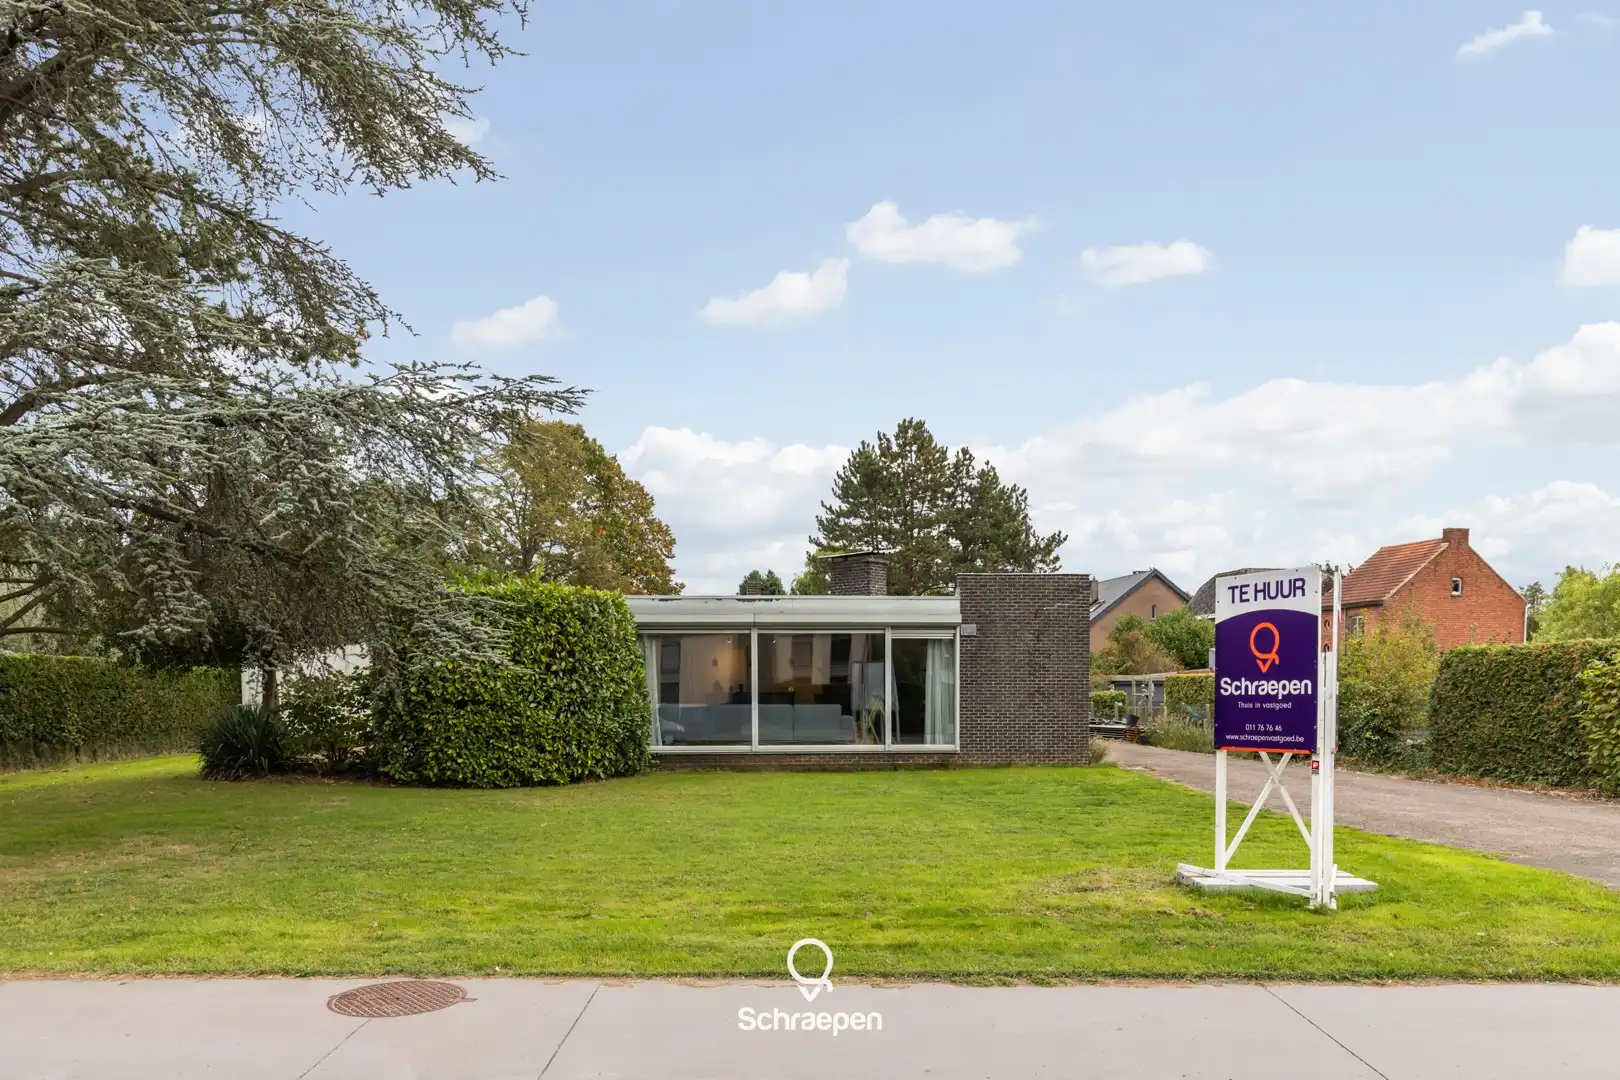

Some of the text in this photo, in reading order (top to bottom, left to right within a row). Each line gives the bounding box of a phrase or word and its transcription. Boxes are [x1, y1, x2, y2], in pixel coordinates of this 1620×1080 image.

[1227, 577, 1306, 604] TE HUUR
[1220, 677, 1312, 699] Schraepen
[1238, 701, 1292, 710] Thuis in vastgoed
[1245, 723, 1256, 731] 011
[1266, 724, 1274, 732] 76
[1274, 724, 1283, 732] 46
[1225, 734, 1305, 744] www.schraepenvastgoed.be
